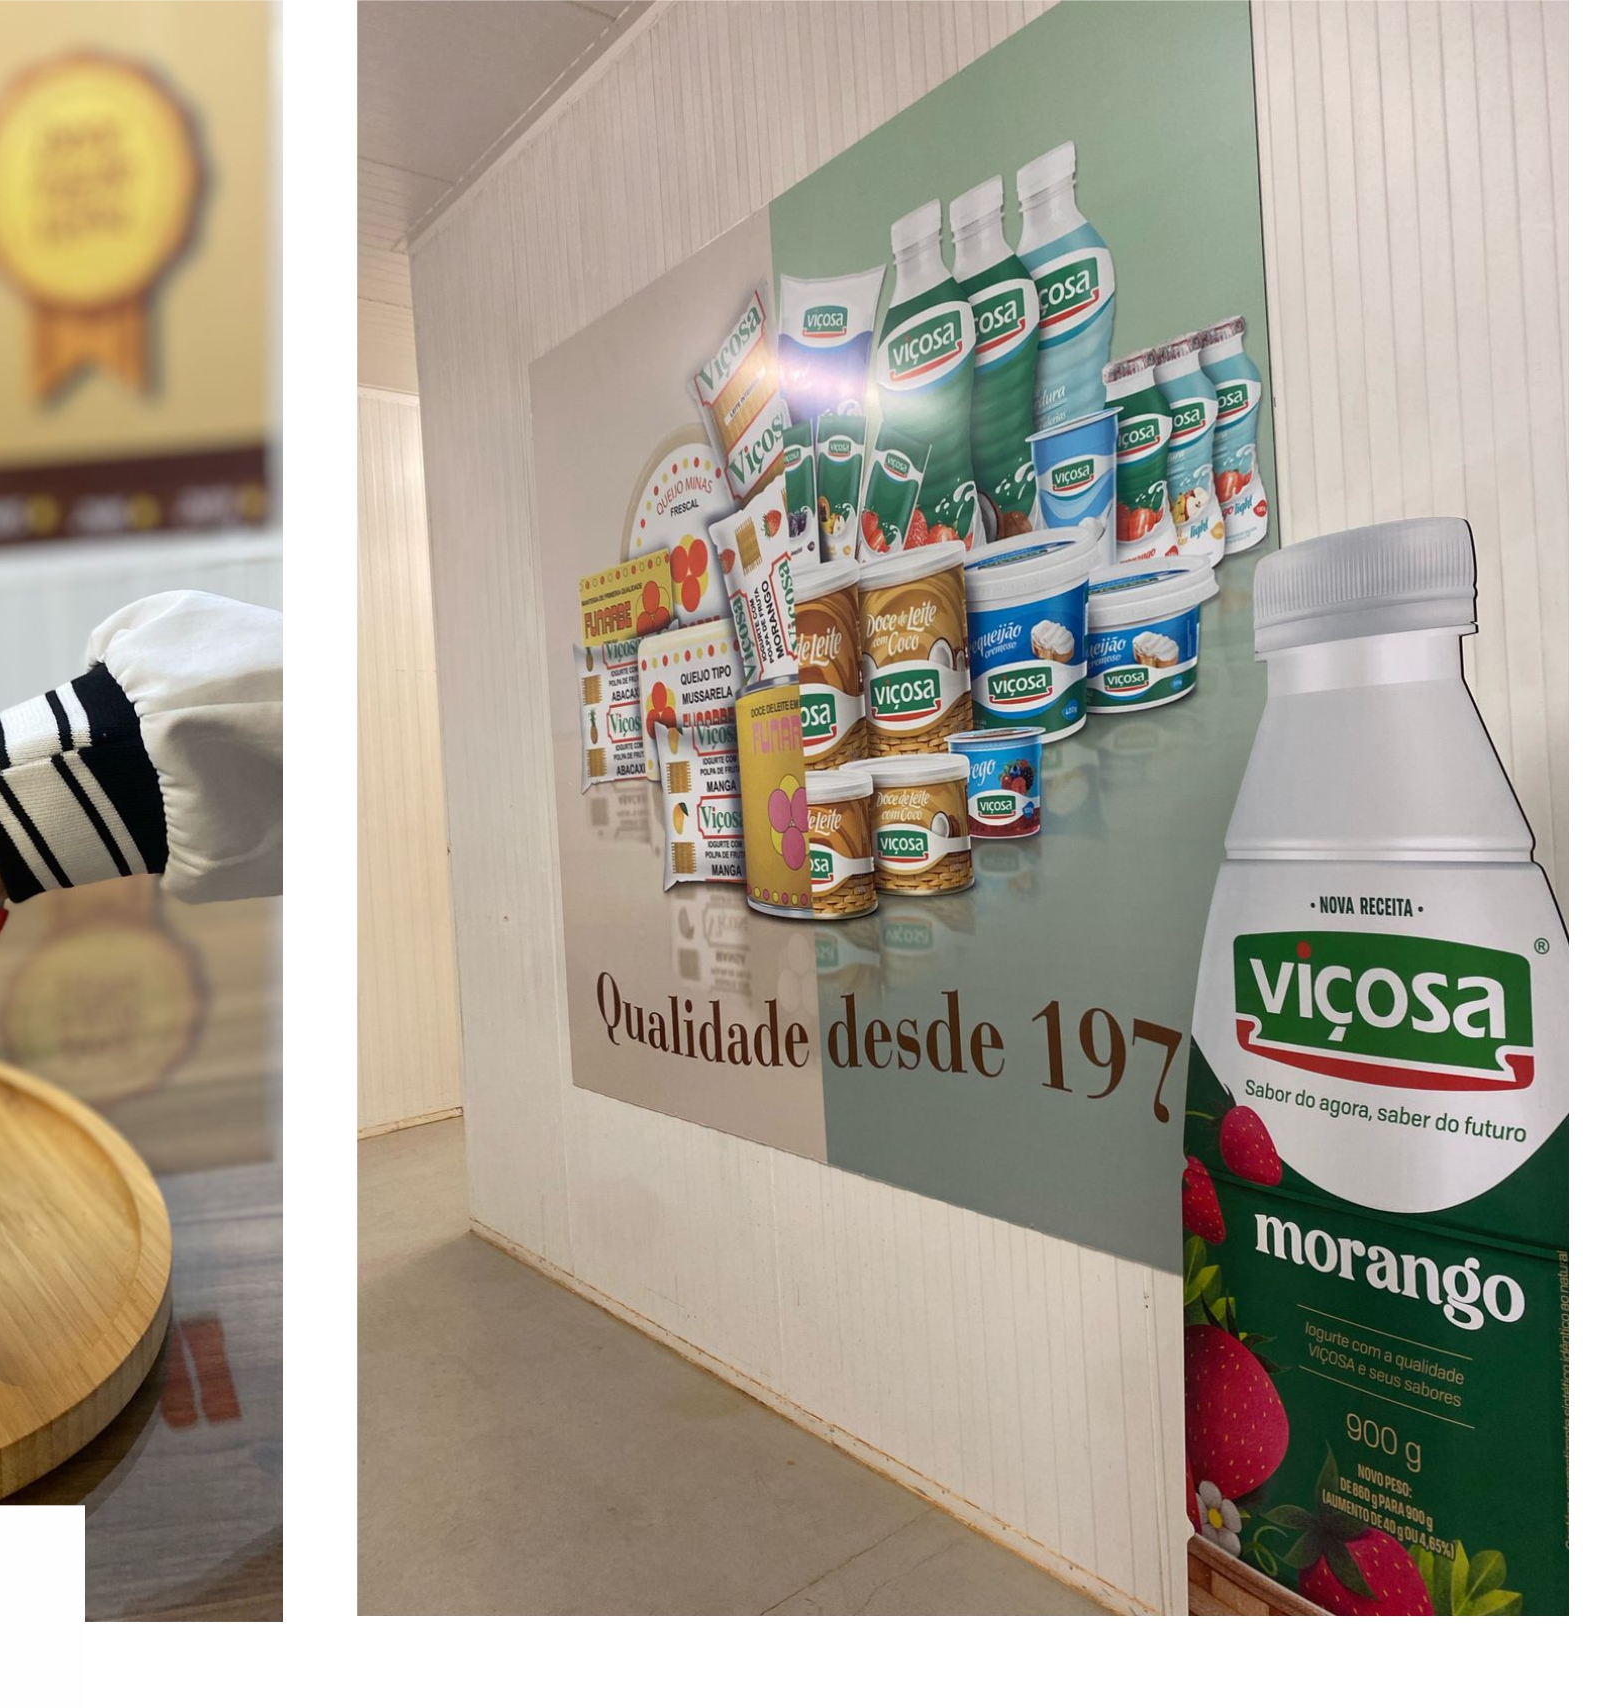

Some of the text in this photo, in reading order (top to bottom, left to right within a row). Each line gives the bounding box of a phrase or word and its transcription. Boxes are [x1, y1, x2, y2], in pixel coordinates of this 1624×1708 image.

[807, 311, 843, 330] viçosa
[698, 305, 762, 390] Viçosa
[892, 322, 955, 365] viçosa
[1055, 464, 1090, 485] viçosa
[656, 476, 713, 515] QUEIJO MINAS
[670, 499, 699, 517] FRESCAL
[761, 580, 785, 659] MORANGO
[866, 600, 937, 638] Doce Leite
[810, 625, 842, 667] Leite
[873, 631, 919, 656] com Coco
[984, 641, 1017, 659] cremoso
[680, 664, 732, 686] QUEIJO TIPO
[992, 672, 1047, 697] viçosa
[1107, 671, 1145, 687] viçosa
[682, 686, 733, 706] MUSSARELA
[874, 678, 935, 710] viçosa
[750, 706, 765, 718] DOCE
[773, 702, 789, 713] LEITE
[789, 700, 799, 711] EM
[616, 763, 646, 776] ABACAXI
[706, 780, 737, 793] MANGA
[876, 791, 899, 807] Doce
[908, 790, 930, 807] Leite
[881, 807, 923, 822] com Coco
[979, 799, 1013, 814] viçosa
[814, 808, 842, 837] Leite
[707, 840, 729, 848] IOGURTE
[720, 850, 728, 858] DE
[880, 835, 925, 854] viçosa
[711, 864, 743, 877] MANGA
[1319, 896, 1414, 917] NOVA RECEITA
[1249, 940, 1507, 1042] viçosa
[596, 971, 1183, 1124] Qualidade desde 197
[1245, 1079, 1527, 1143] Sabor do agora, saber do futuro
[1254, 1213, 1526, 1331] morango
[1305, 1321, 1464, 1385] Iogurte com a qualidade
[1308, 1343, 1462, 1407] VIÇOSA e seus sabores
[1346, 1413, 1421, 1473] 900 g
[1358, 1463, 1413, 1499] NOVO PESO:
[1340, 1477, 1351, 1495] DE
[1352, 1486, 1371, 1502] 860
[1379, 1494, 1404, 1517] PARA
[1406, 1506, 1426, 1525] 900
[1322, 1489, 1369, 1523] (AUMENTO
[1371, 1509, 1383, 1528] DE
[1383, 1518, 1396, 1534] 40
[1404, 1526, 1419, 1544] OU
